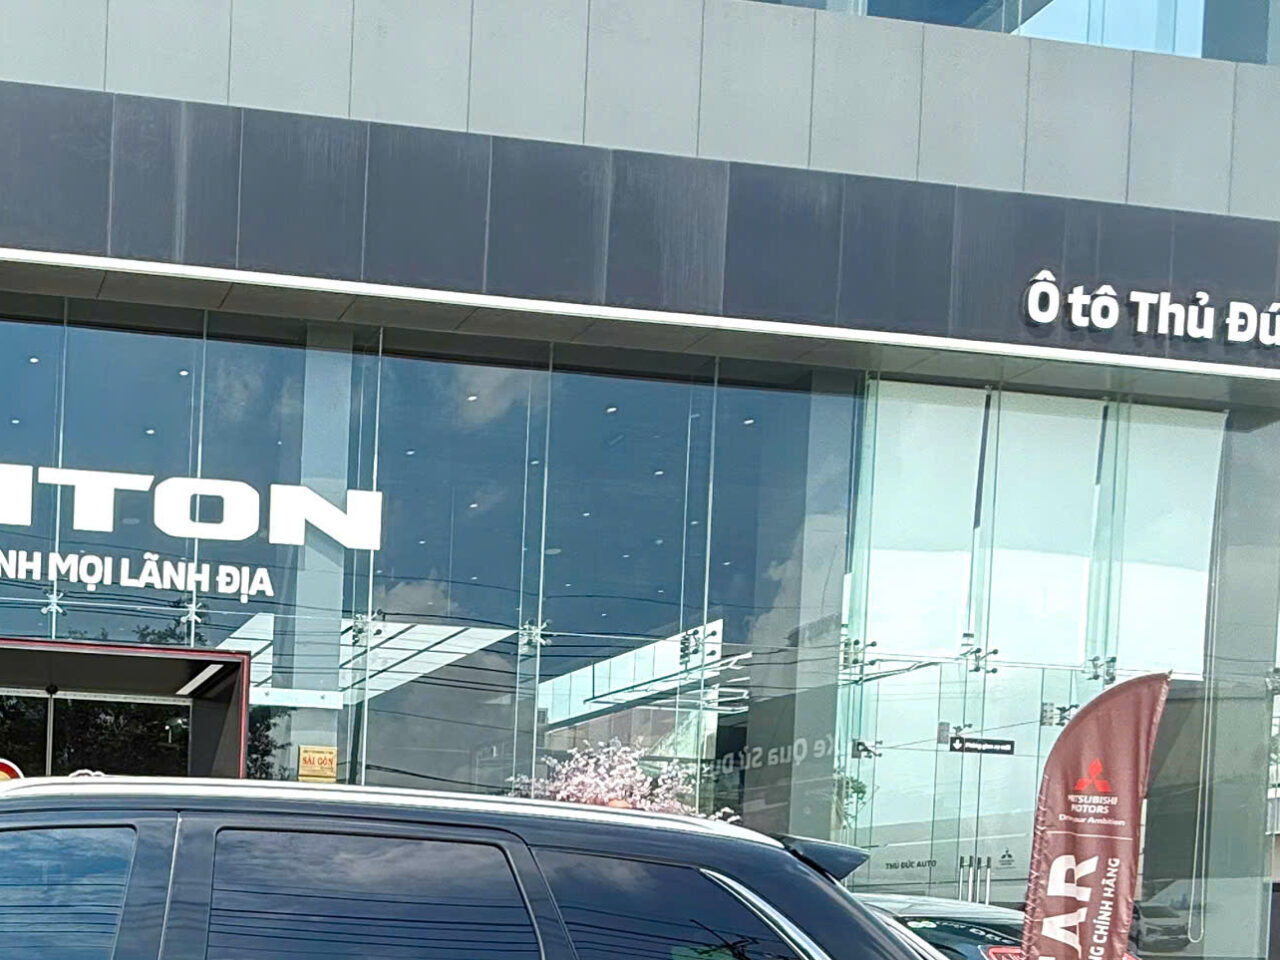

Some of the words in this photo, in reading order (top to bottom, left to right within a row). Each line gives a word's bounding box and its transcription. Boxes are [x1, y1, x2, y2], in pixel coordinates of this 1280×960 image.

[1028, 269, 1060, 324] Ô
[1068, 284, 1119, 329] tô
[1129, 290, 1214, 339] Thủ
[1225, 301, 1280, 347] Đứ
[48, 554, 112, 592] MỌI
[119, 555, 209, 594] LÃNH
[216, 569, 274, 603] ĐỊA
[1101, 857, 1120, 900] HÃNG
[1093, 901, 1114, 944] CHÍNH
